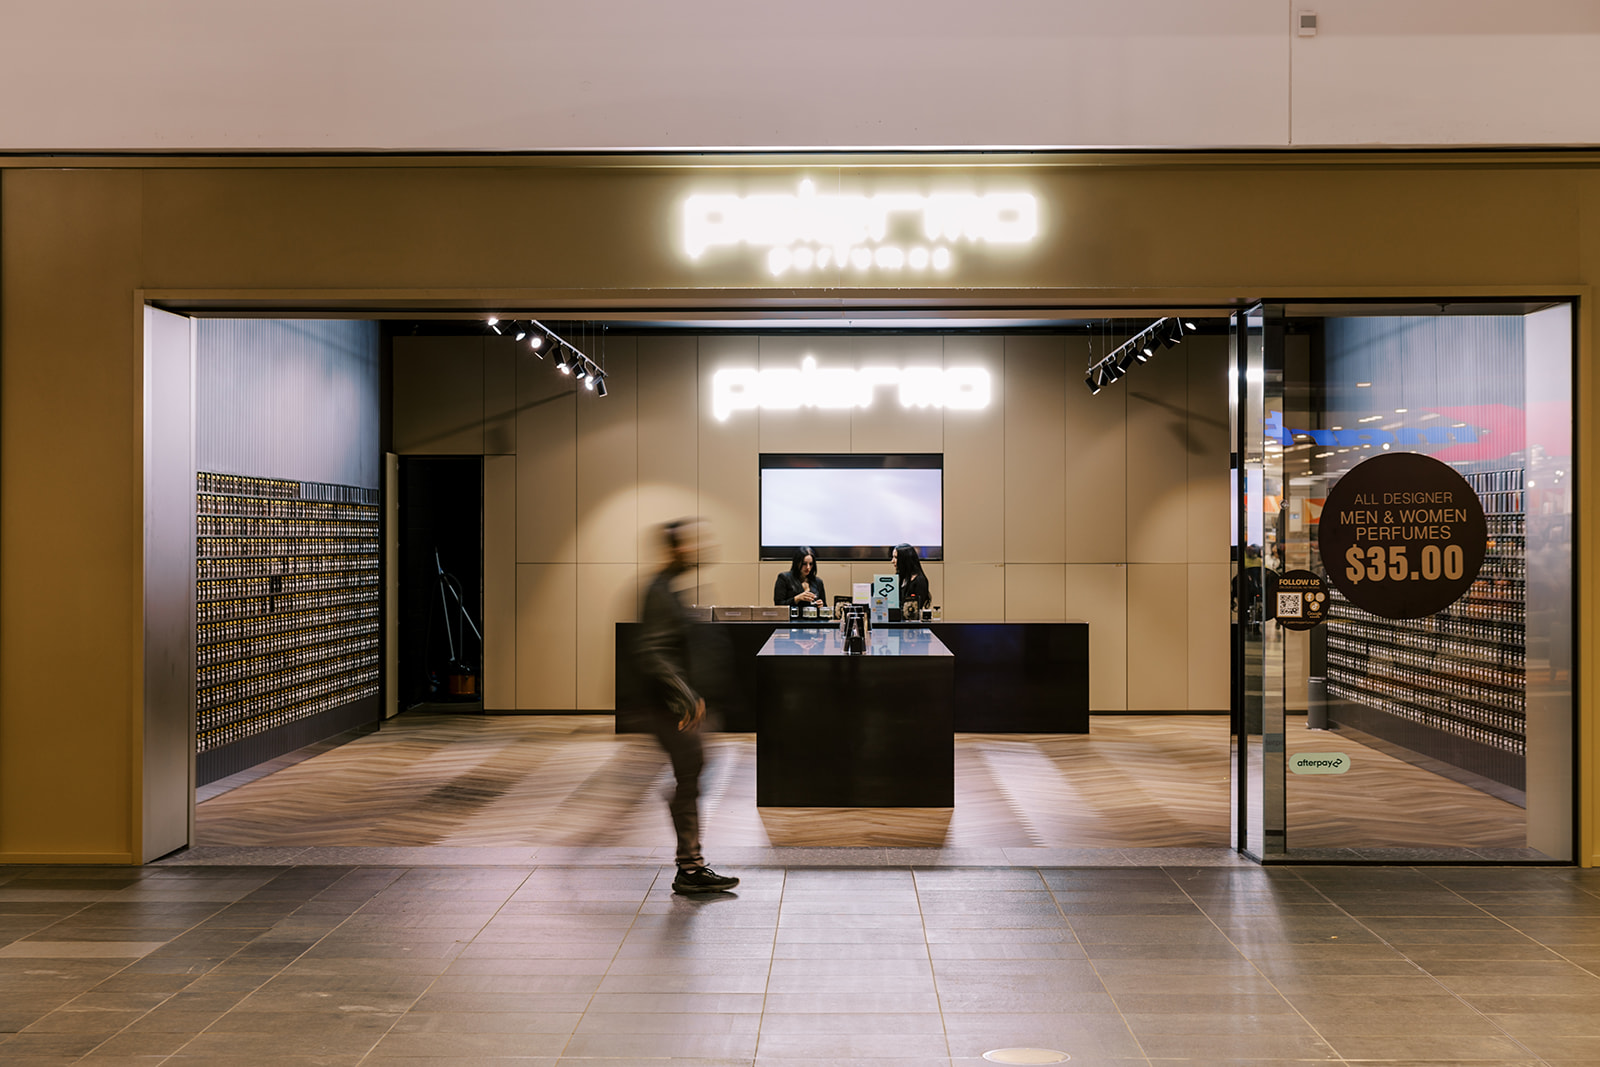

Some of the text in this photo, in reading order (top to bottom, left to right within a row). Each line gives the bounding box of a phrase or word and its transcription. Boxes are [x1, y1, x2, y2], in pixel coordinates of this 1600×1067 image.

[1354, 491, 1453, 505] ALL DESIGNER
[1340, 508, 1467, 525] MEN & WOMEN
[1356, 525, 1451, 541] PERFUMES
[1345, 543, 1464, 585] $35.00
[1279, 578, 1320, 586] FOLLOW US
[1297, 758, 1333, 768] afterpay
